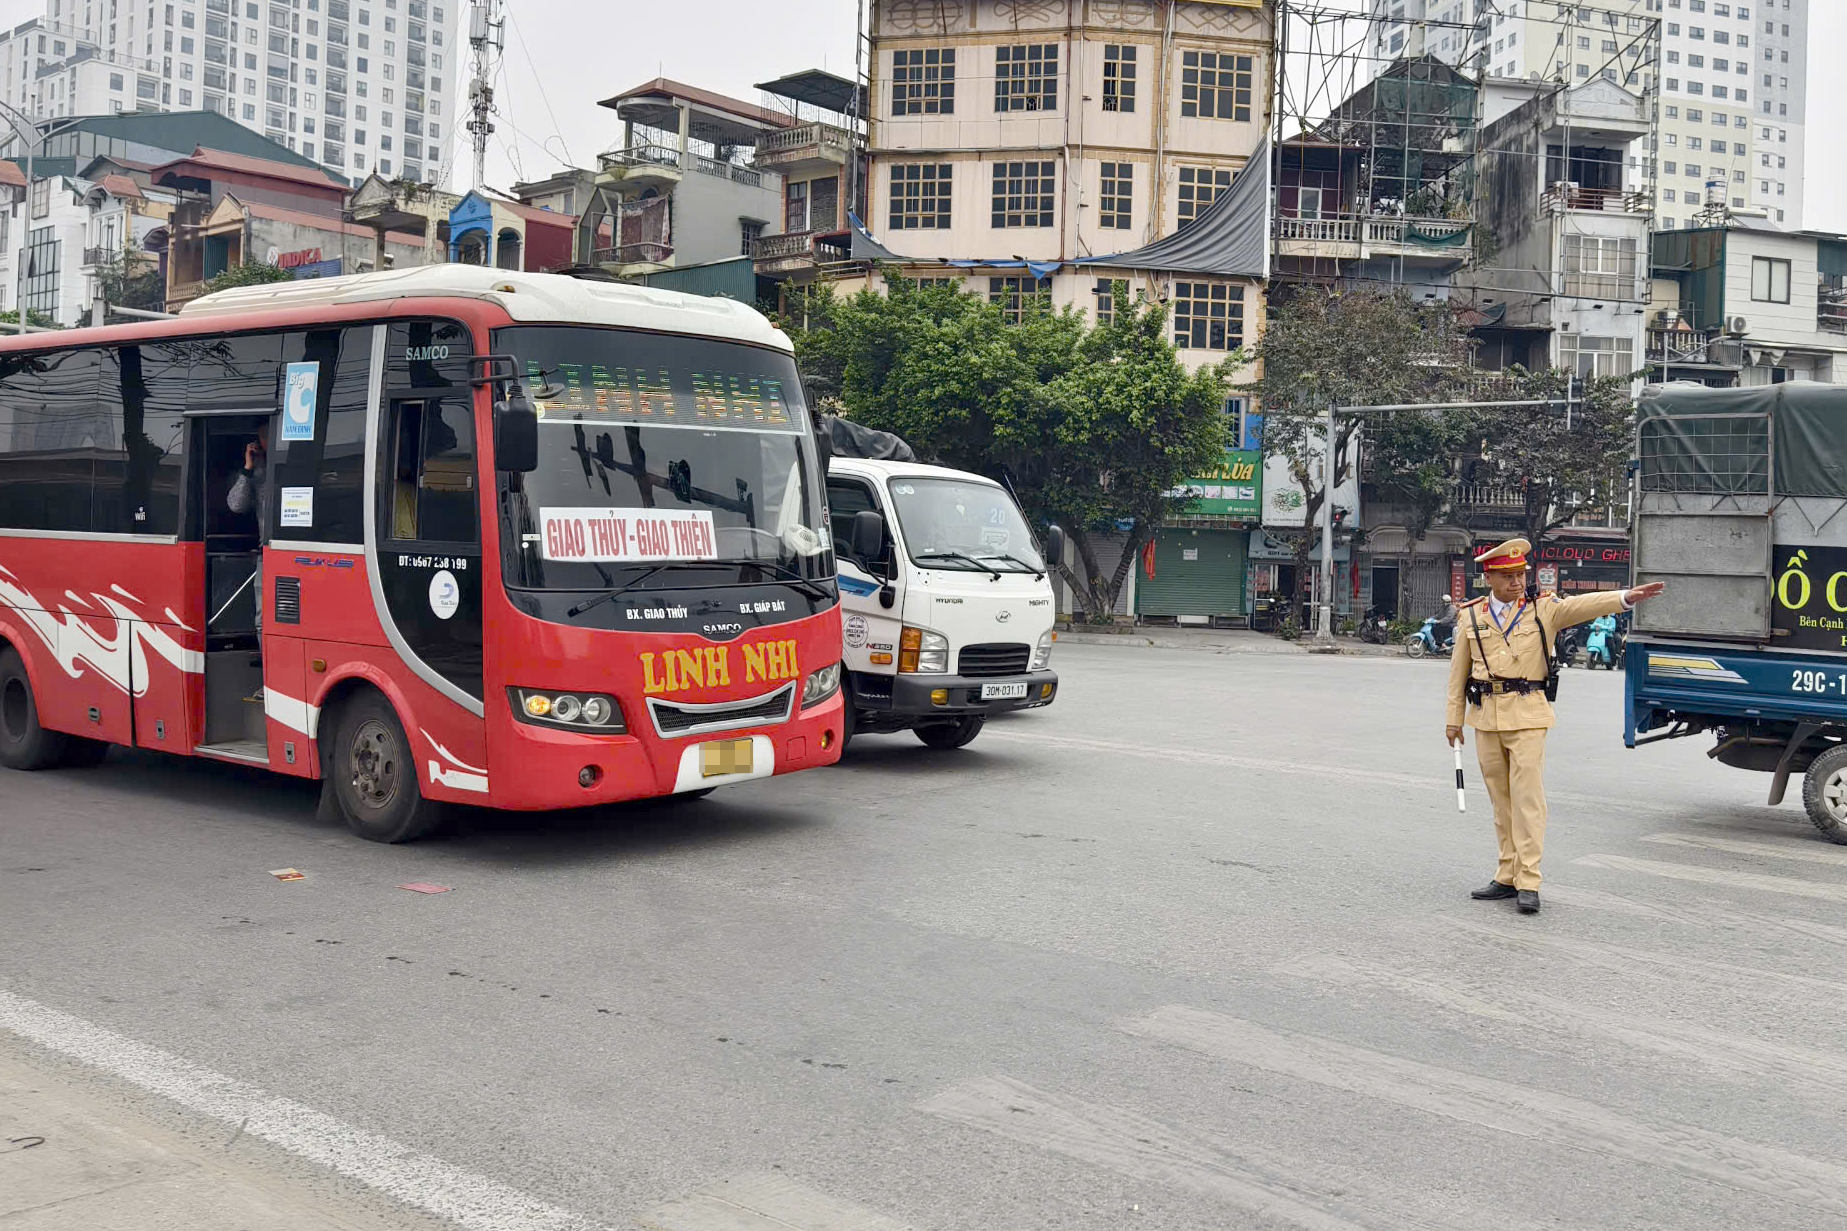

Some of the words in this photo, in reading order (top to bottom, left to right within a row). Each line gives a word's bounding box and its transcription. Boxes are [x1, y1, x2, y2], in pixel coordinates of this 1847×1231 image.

[405, 345, 449, 360] SAMCO
[289, 371, 305, 389] Big
[547, 518, 586, 558] GIAO
[636, 518, 670, 556] GIAO
[451, 558, 467, 570] 199
[626, 608, 643, 620] BX.
[643, 608, 665, 619] GIAO
[739, 603, 753, 614] BX.
[702, 623, 742, 635] SAMCO
[1819, 616, 1844, 631] Cạnh
[640, 645, 731, 694] LINH
[741, 639, 800, 683] NHI
